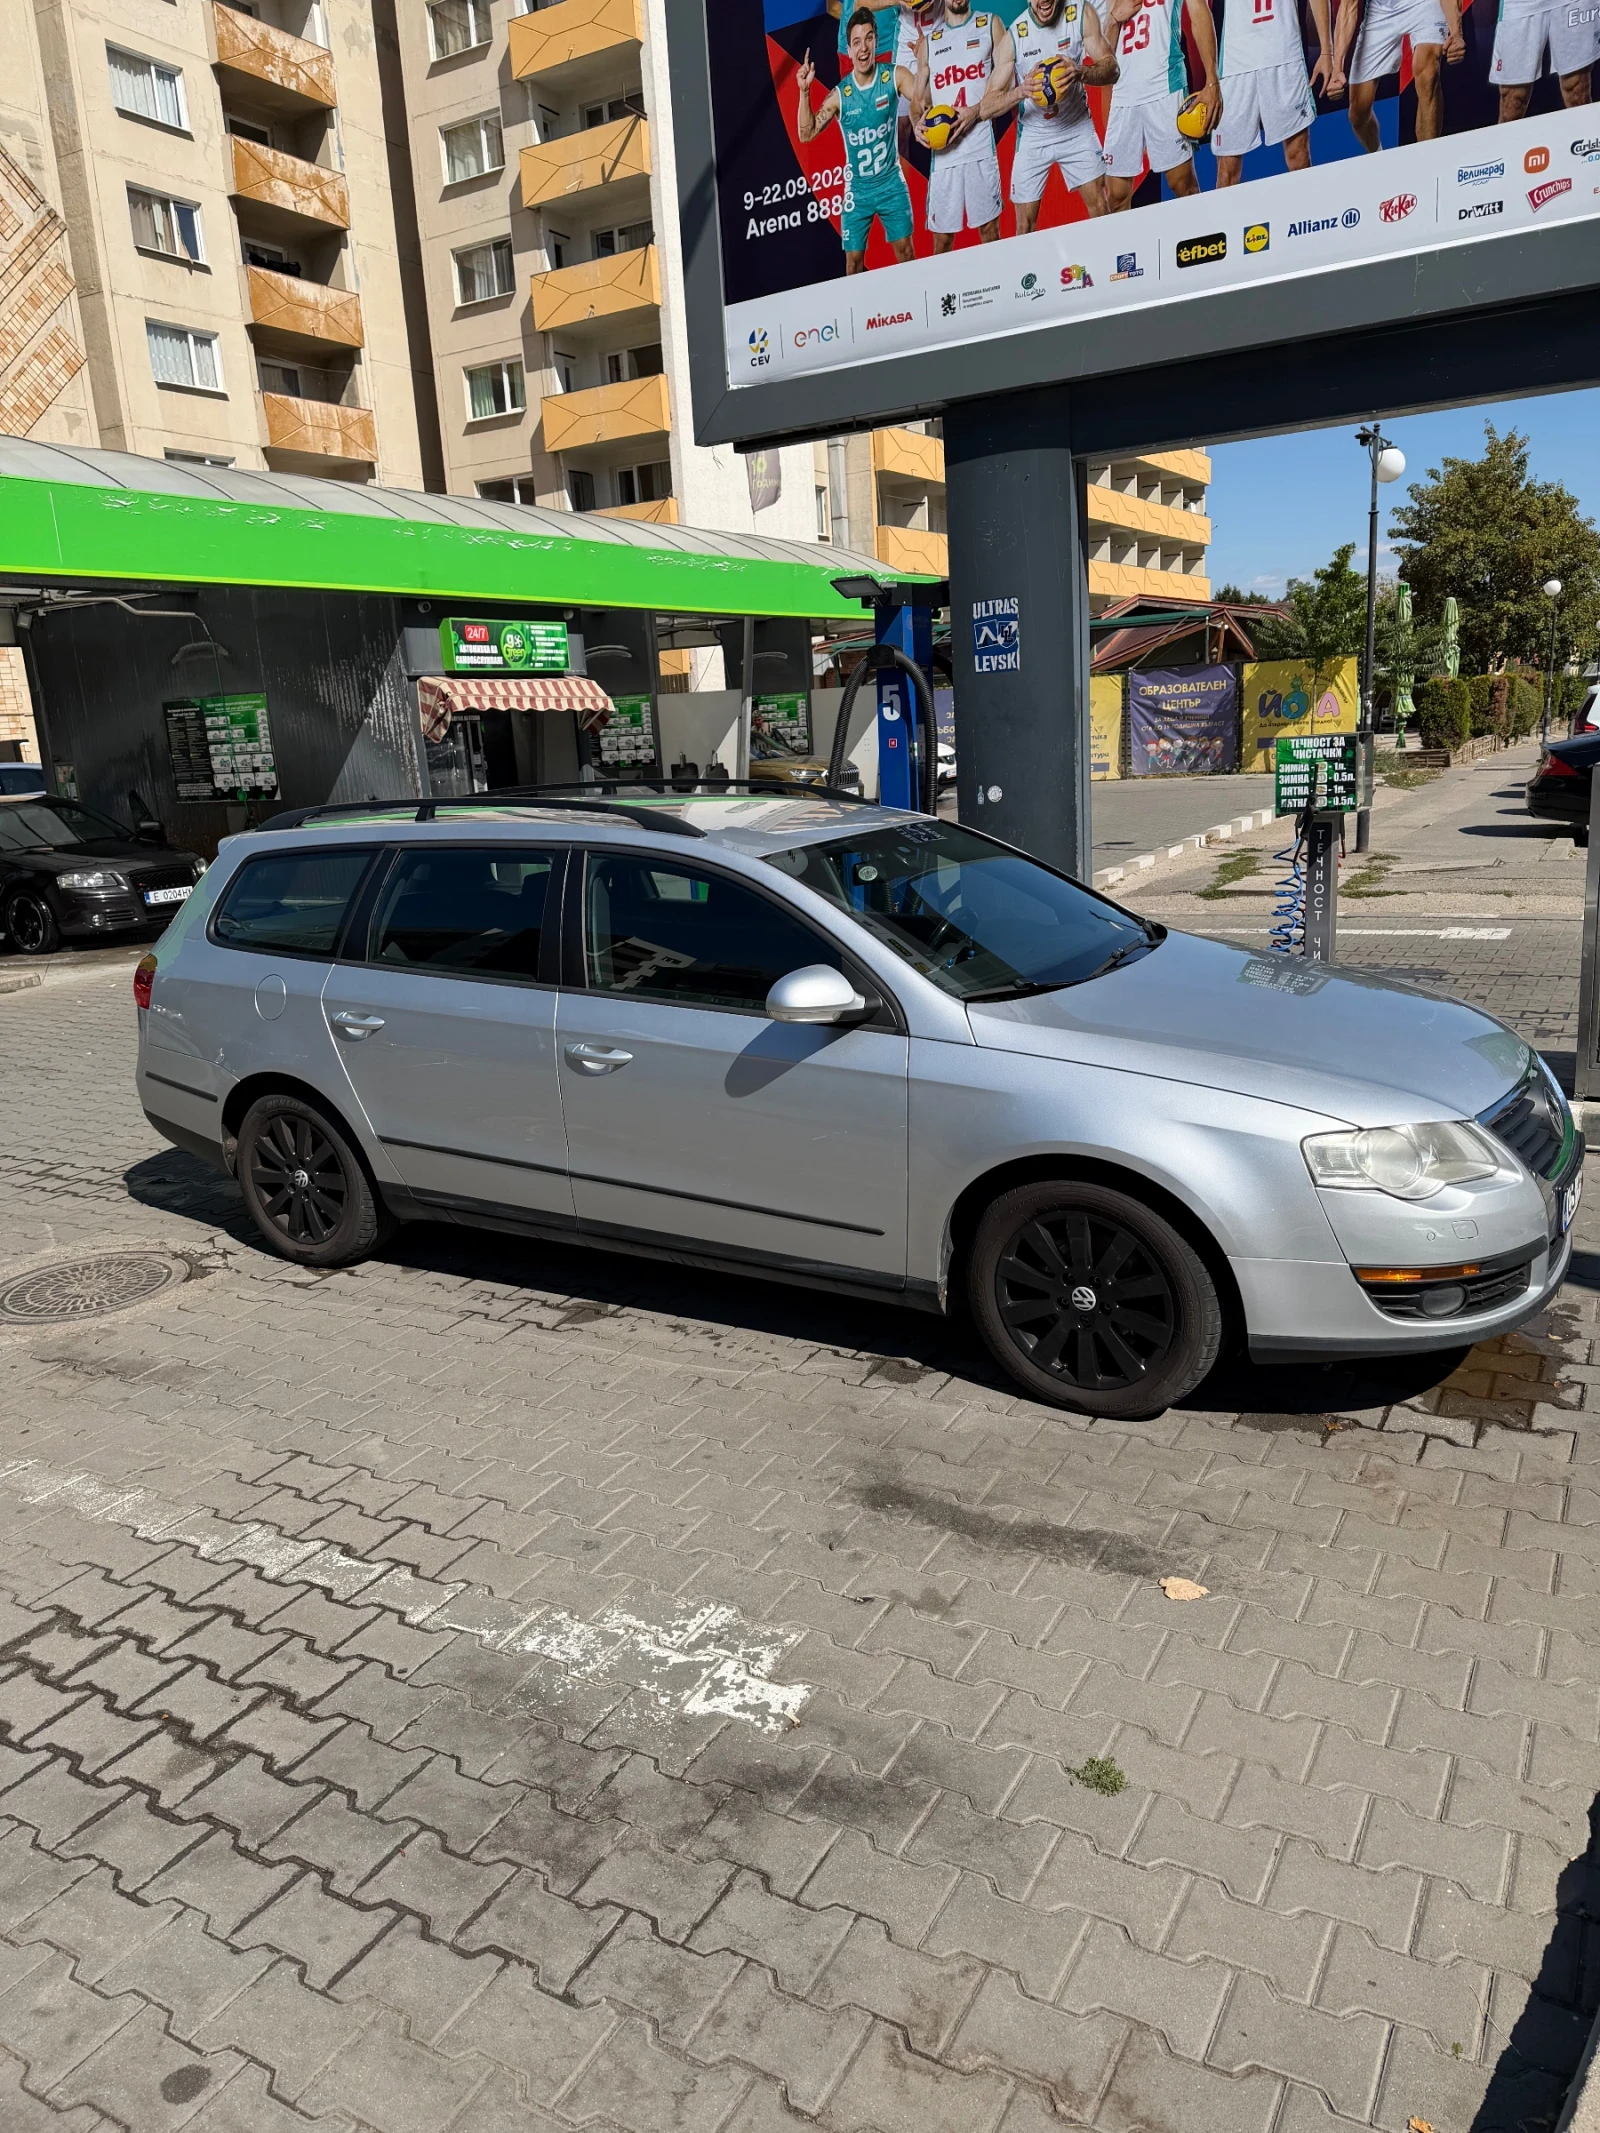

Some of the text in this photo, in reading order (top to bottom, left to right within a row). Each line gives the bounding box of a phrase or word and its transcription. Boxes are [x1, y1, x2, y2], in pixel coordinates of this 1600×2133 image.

[1568, 8, 1600, 27] Eur
[1123, 14, 1150, 55] 23
[933, 60, 986, 90] efbet
[848, 117, 893, 146] efbet
[1570, 138, 1600, 156] Carls
[857, 141, 888, 177] 22
[1458, 162, 1505, 183] Велинград
[1533, 179, 1571, 204] Crunchips
[746, 191, 855, 240] Arena 8888
[1288, 216, 1338, 237] Allianz
[1178, 239, 1226, 262] efbet
[794, 318, 839, 347] enel
[750, 355, 770, 366] CEV
[972, 596, 1018, 619] ULTRAS
[467, 627, 486, 639] 24/7
[1139, 680, 1227, 696] ОБРАЗОВАТЕЛЕН
[882, 684, 901, 721] 5
[1162, 698, 1201, 710] ЦЕНТЪР
[1291, 737, 1345, 749] ТЕЧНОСТ ЗА
[1293, 748, 1342, 759] ЧИСТАЧКИ
[1279, 763, 1309, 773] ЗИМНА
[1279, 774, 1309, 784] ЗИМНА
[1281, 786, 1309, 796] ЛЯТНА
[1313, 829, 1326, 921] ТЕЧНОСТ
